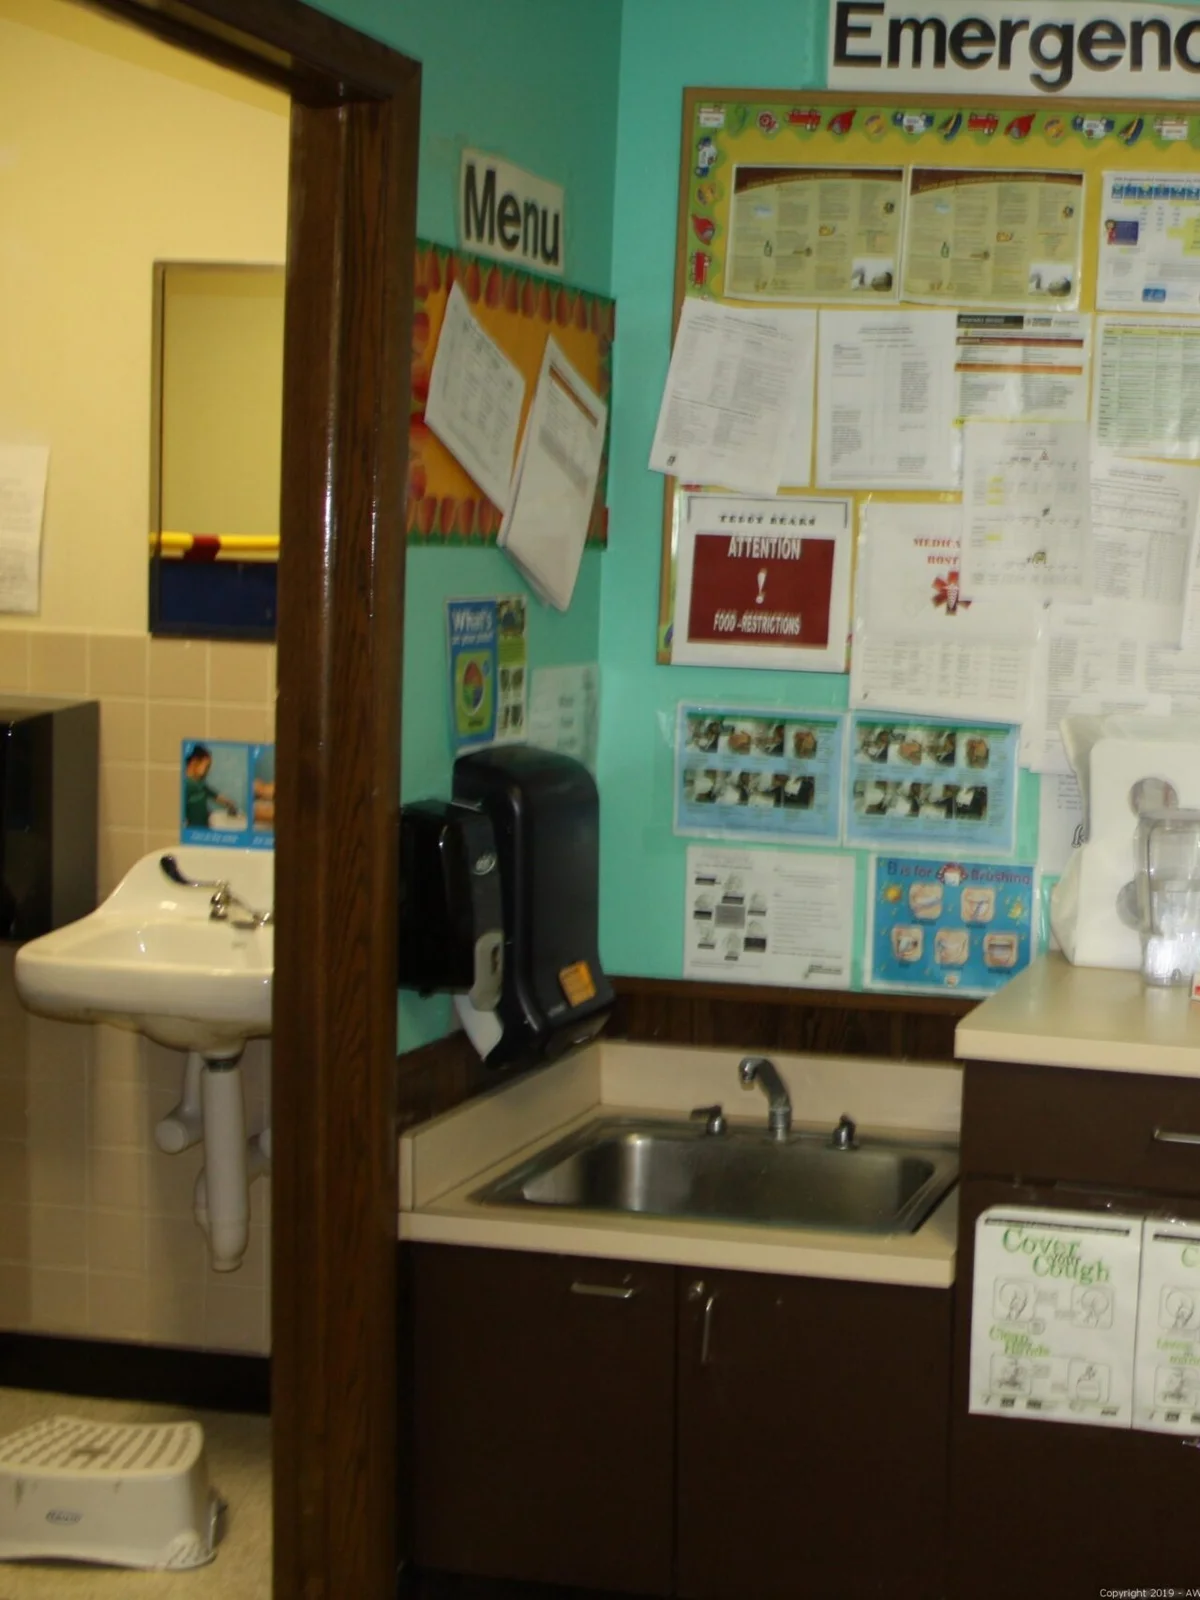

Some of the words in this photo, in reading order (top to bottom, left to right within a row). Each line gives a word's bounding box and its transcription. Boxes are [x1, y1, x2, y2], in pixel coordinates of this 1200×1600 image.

[464, 164, 561, 265] Menu
[727, 535, 802, 561] ATTENTION
[713, 610, 735, 633] FOOD
[913, 865, 932, 878] for
[1002, 1226, 1081, 1256] Cover
[1032, 1254, 1111, 1285] Cough
